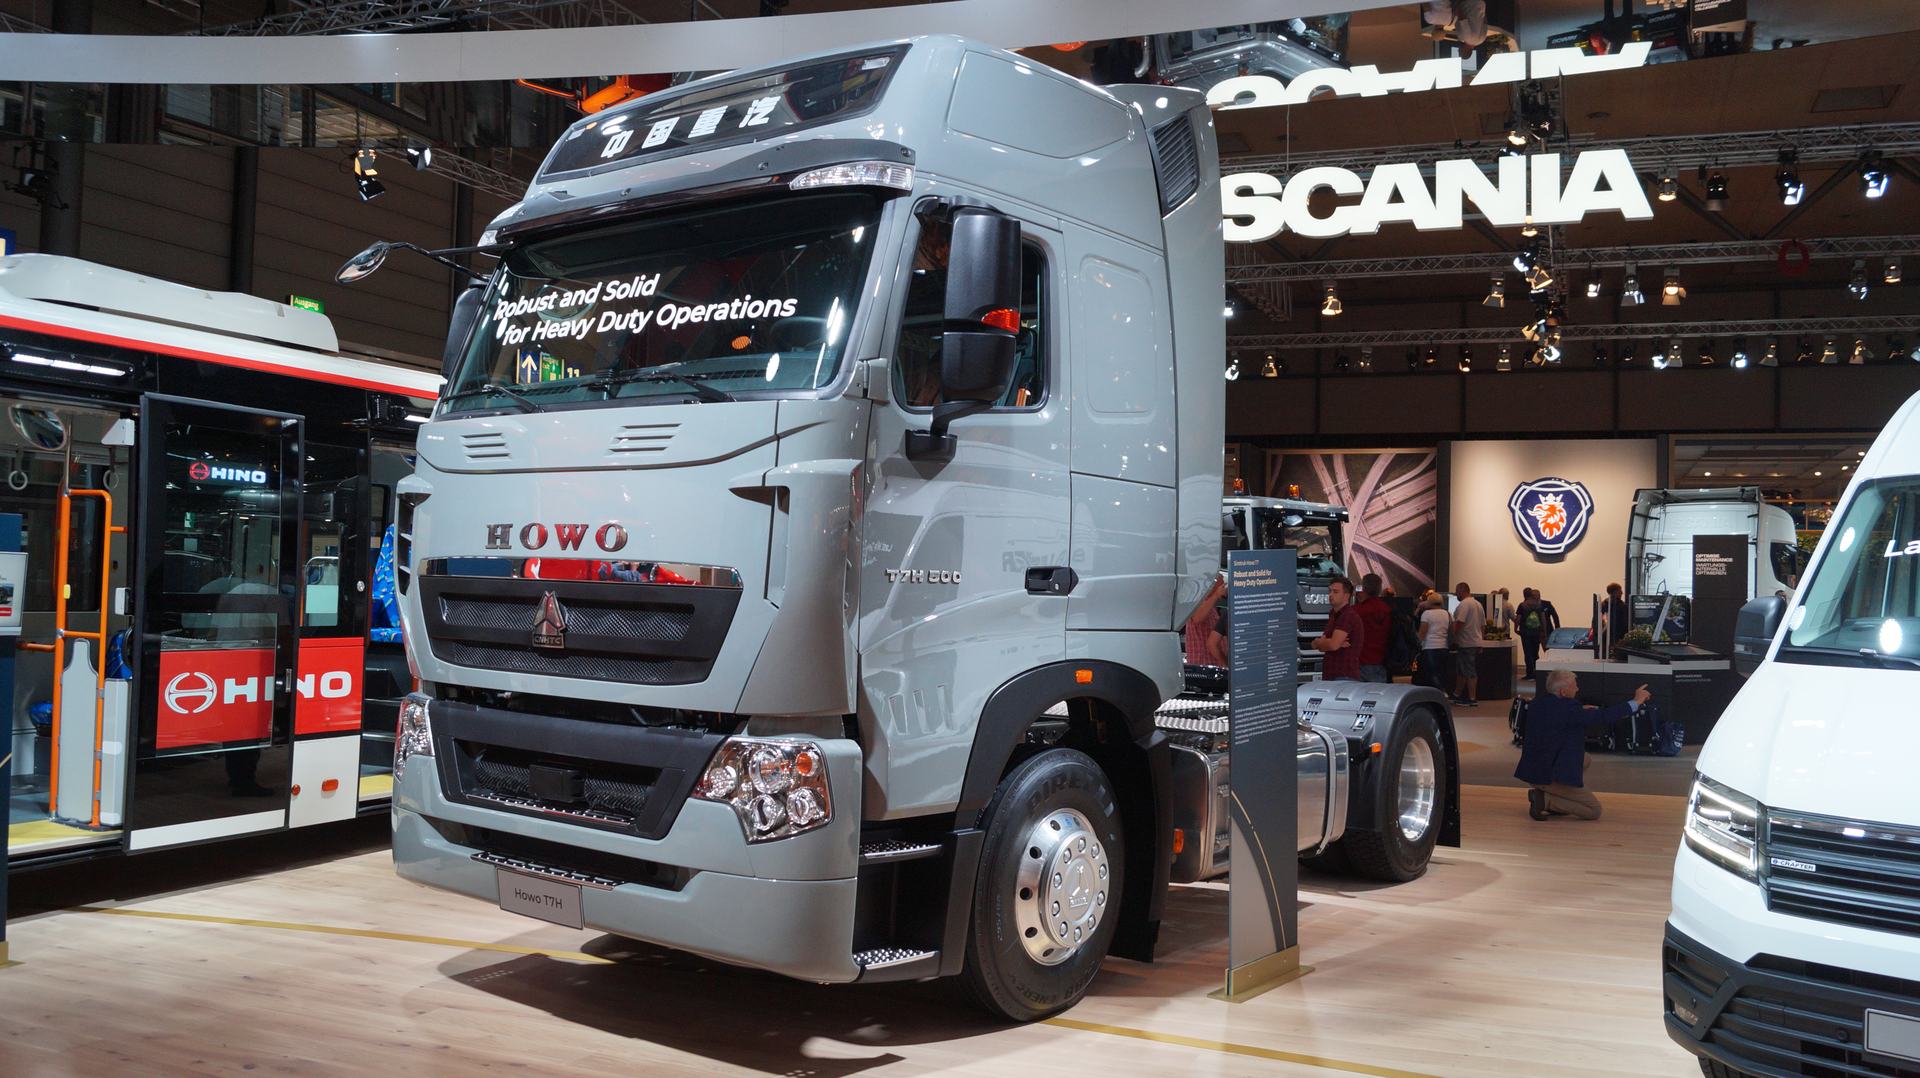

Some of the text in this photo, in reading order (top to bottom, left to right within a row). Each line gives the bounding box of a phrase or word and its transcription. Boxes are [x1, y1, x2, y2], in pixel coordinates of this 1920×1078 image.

[1220, 149, 1654, 242] SCANIA
[493, 273, 661, 320] Robust and Solid
[502, 294, 798, 346] for Heavy Duty Operations
[211, 467, 266, 483] HINO
[485, 522, 629, 552] HOWO
[886, 568, 962, 584] T7H 500
[1233, 570, 1248, 578] Robust
[1233, 580, 1246, 588] Heavy
[1304, 594, 1330, 604] SCAN
[514, 887, 563, 909] Howo T7H
